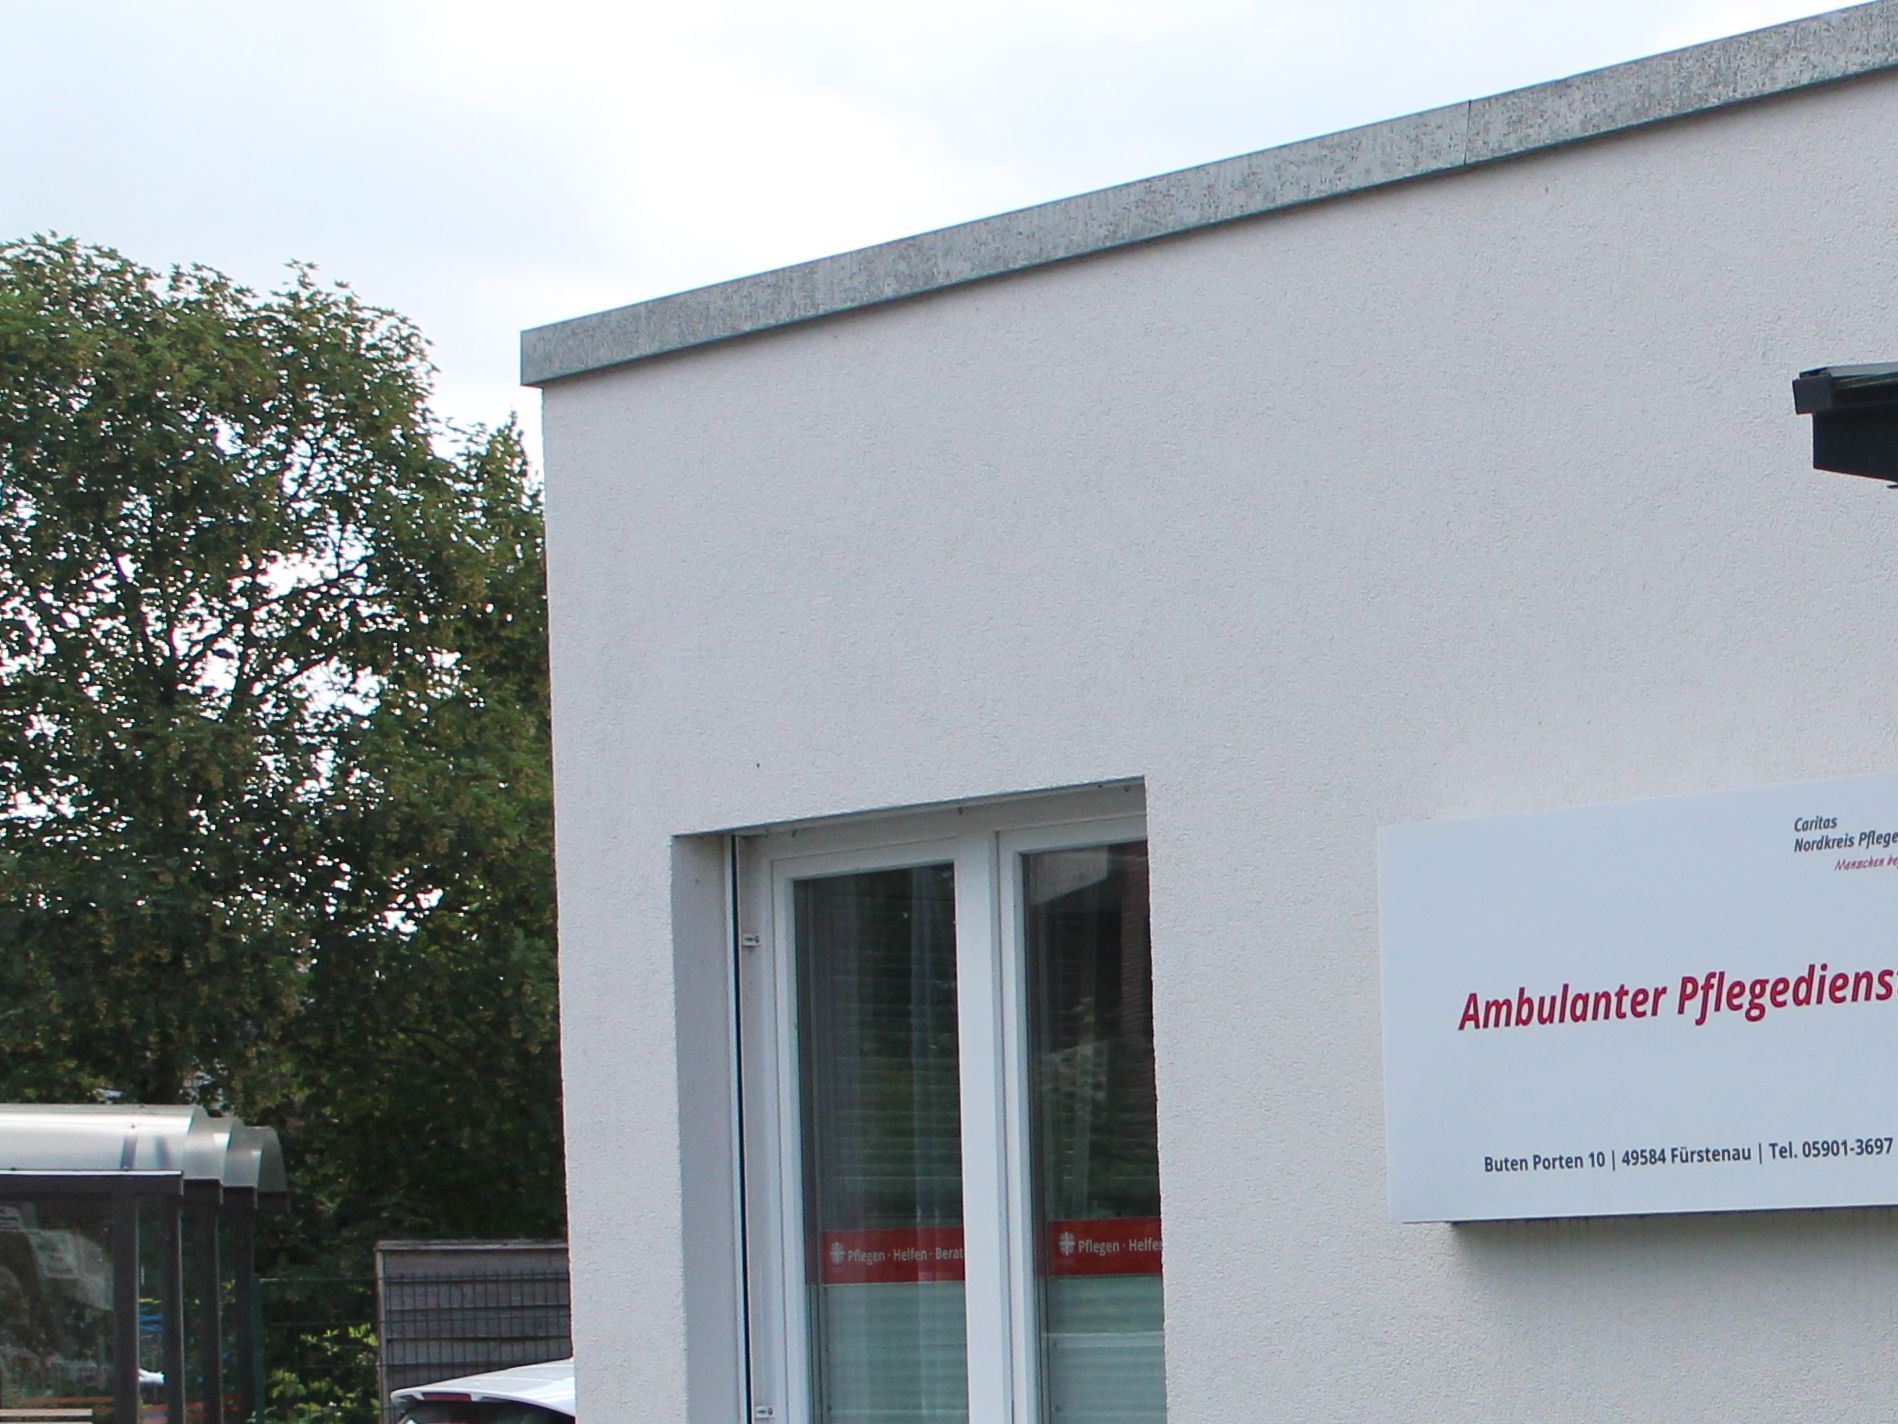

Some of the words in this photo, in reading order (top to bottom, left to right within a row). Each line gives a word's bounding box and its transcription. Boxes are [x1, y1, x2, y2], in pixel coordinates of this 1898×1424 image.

[1793, 815, 1838, 832] Caritas
[1793, 833, 1855, 853] Nordkreis
[1858, 829, 1898, 850] Pflege
[1833, 855, 1885, 871] Menschen
[1457, 982, 1668, 1031] Ambulanter
[1484, 1156, 1529, 1172] Buten
[1532, 1153, 1584, 1171] Porten
[1588, 1151, 1606, 1168] 10
[1621, 1148, 1667, 1167] 49584
[1670, 1146, 1752, 1164] Fürstenau
[1768, 1141, 1798, 1160] Tel.
[1801, 1137, 1894, 1158] 05901-3697
[847, 1248, 885, 1265] Pflegen
[892, 1247, 928, 1261] Helfen
[935, 1246, 965, 1260] Berat
[1078, 1238, 1120, 1256] Pflegen
